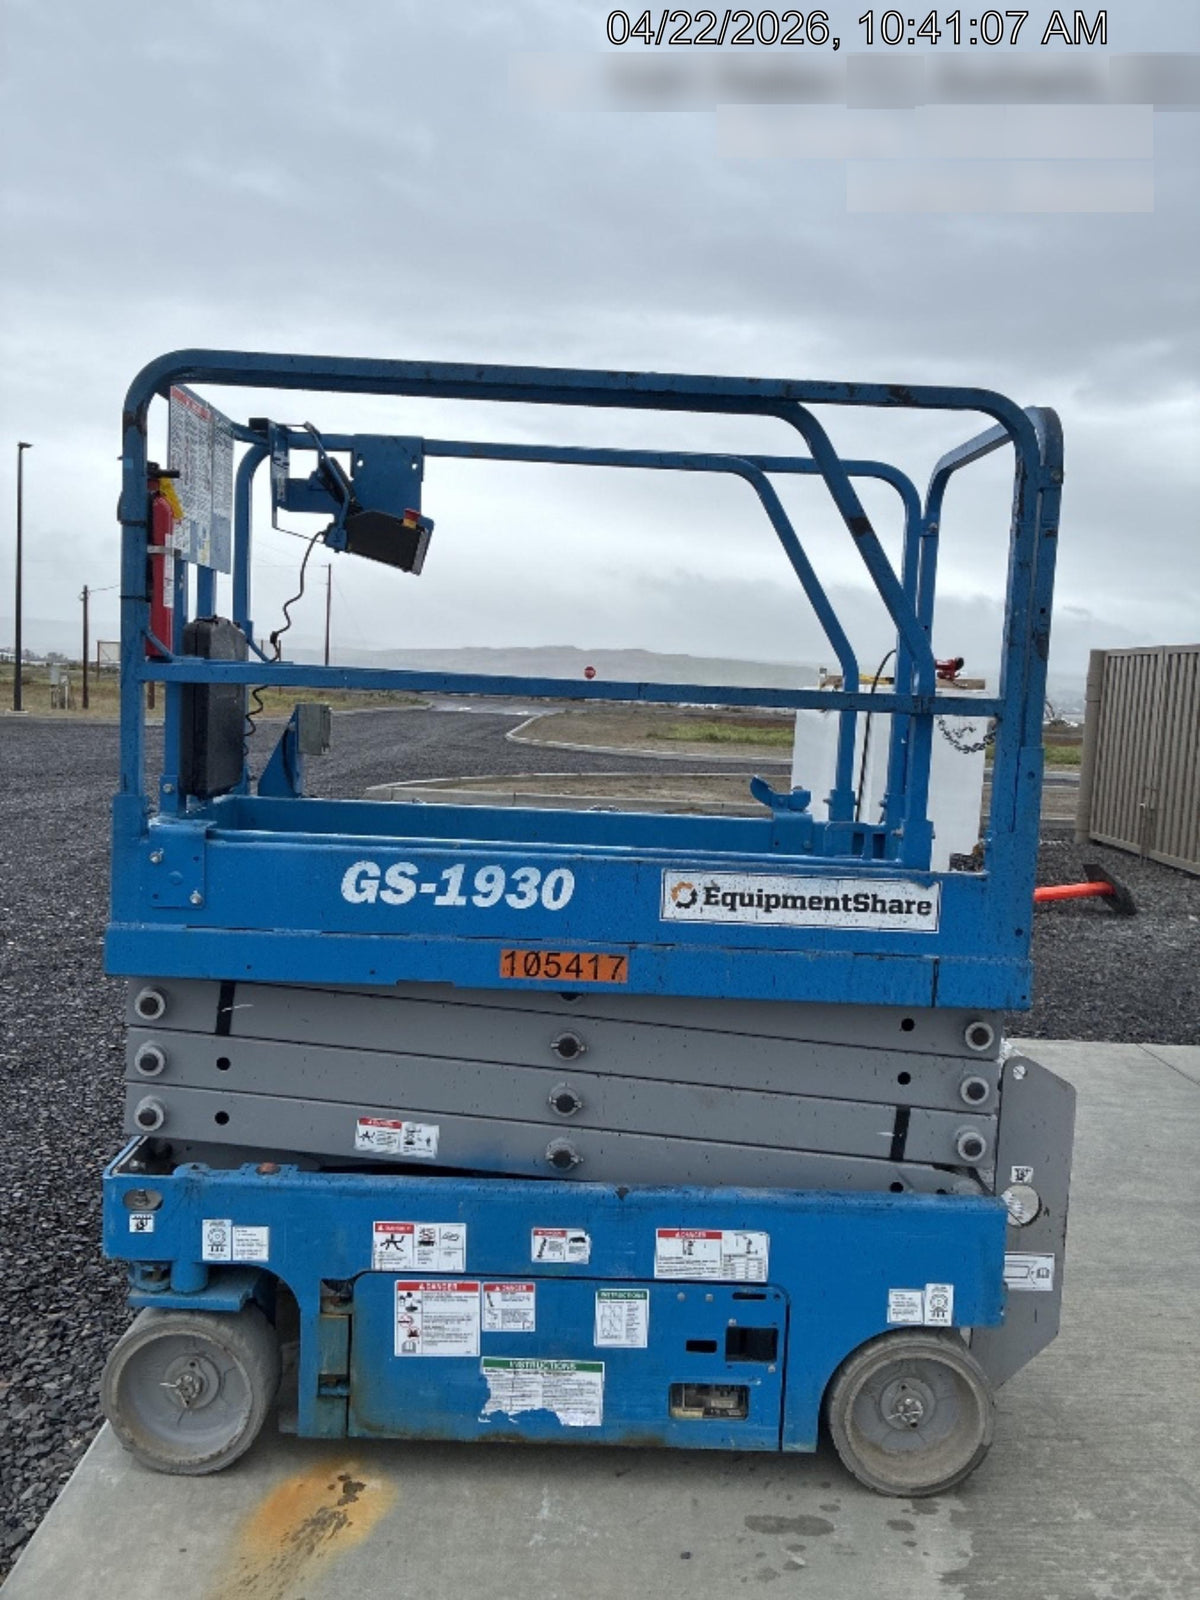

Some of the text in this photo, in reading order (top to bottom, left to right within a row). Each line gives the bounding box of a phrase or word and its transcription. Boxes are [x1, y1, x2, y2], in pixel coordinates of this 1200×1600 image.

[340, 860, 575, 911] GS-1930
[703, 886, 933, 916] EquipmentShare
[502, 950, 626, 981] 105417
